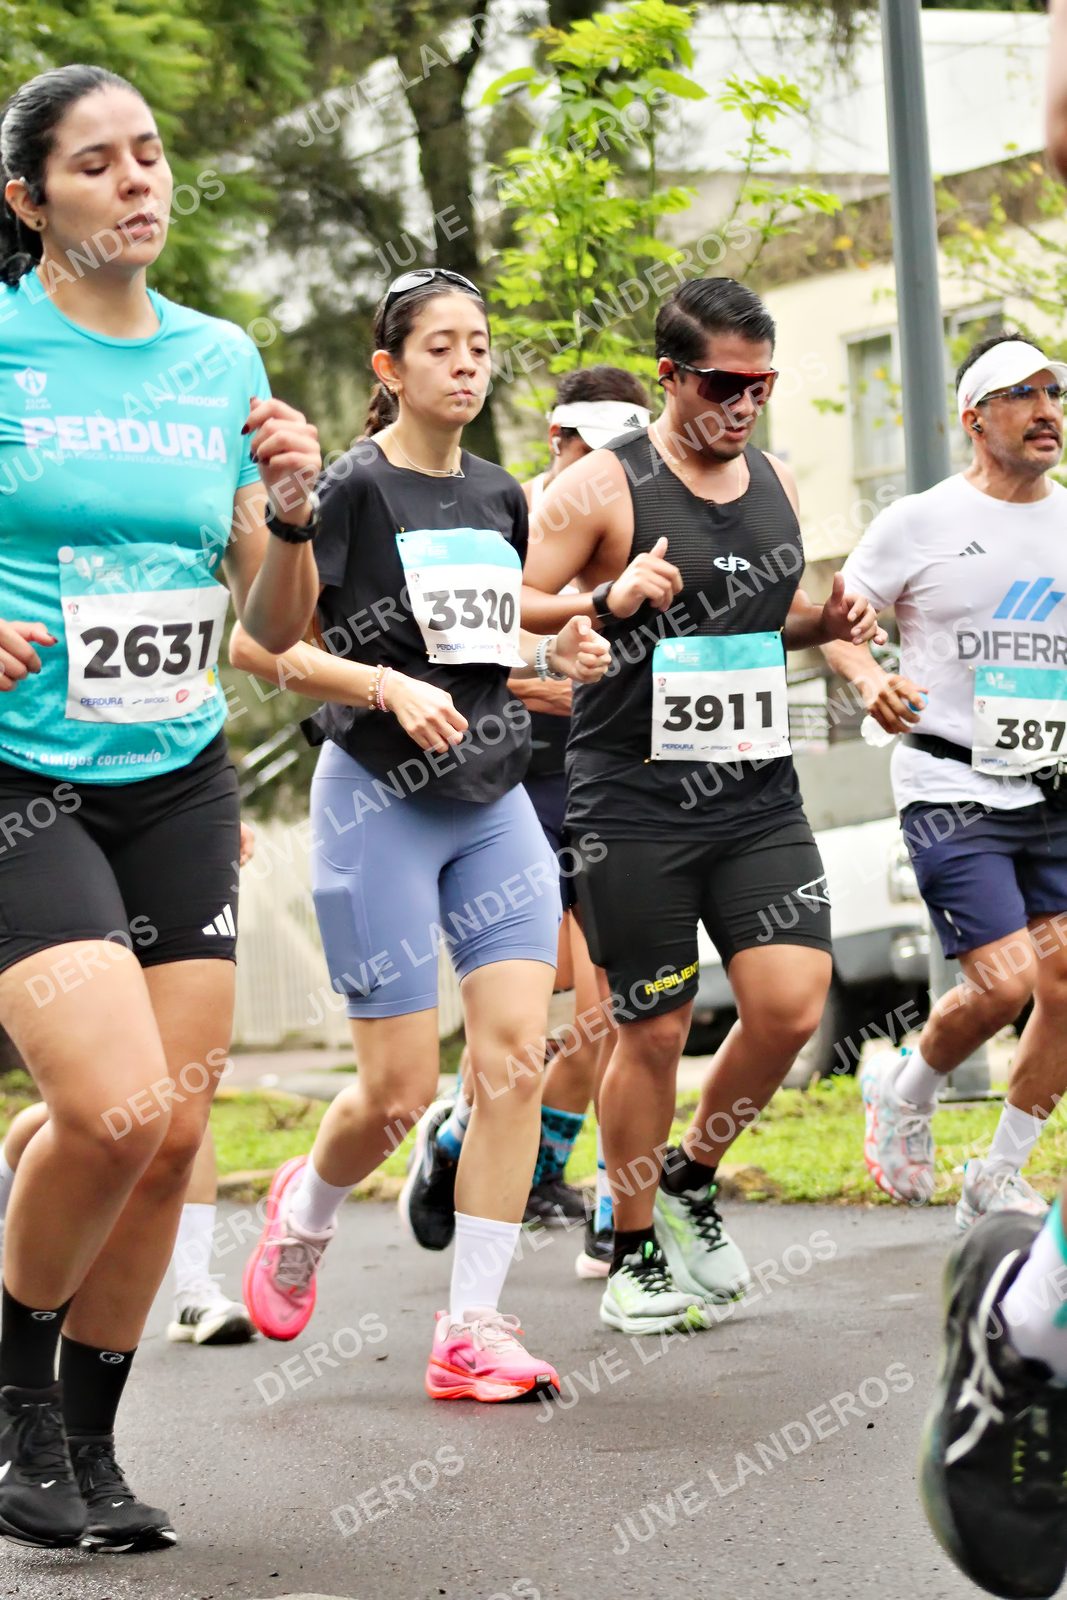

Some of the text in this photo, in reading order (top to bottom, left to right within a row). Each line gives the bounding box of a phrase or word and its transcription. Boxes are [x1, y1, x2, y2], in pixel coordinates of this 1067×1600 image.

[20, 415, 228, 464] PERDURA
[423, 588, 515, 633] 3320
[80, 620, 214, 679] 2631
[662, 691, 772, 731] 3911
[995, 718, 1066, 752] 387
[38, 752, 93, 770] amigos
[97, 749, 161, 765] corriendo
